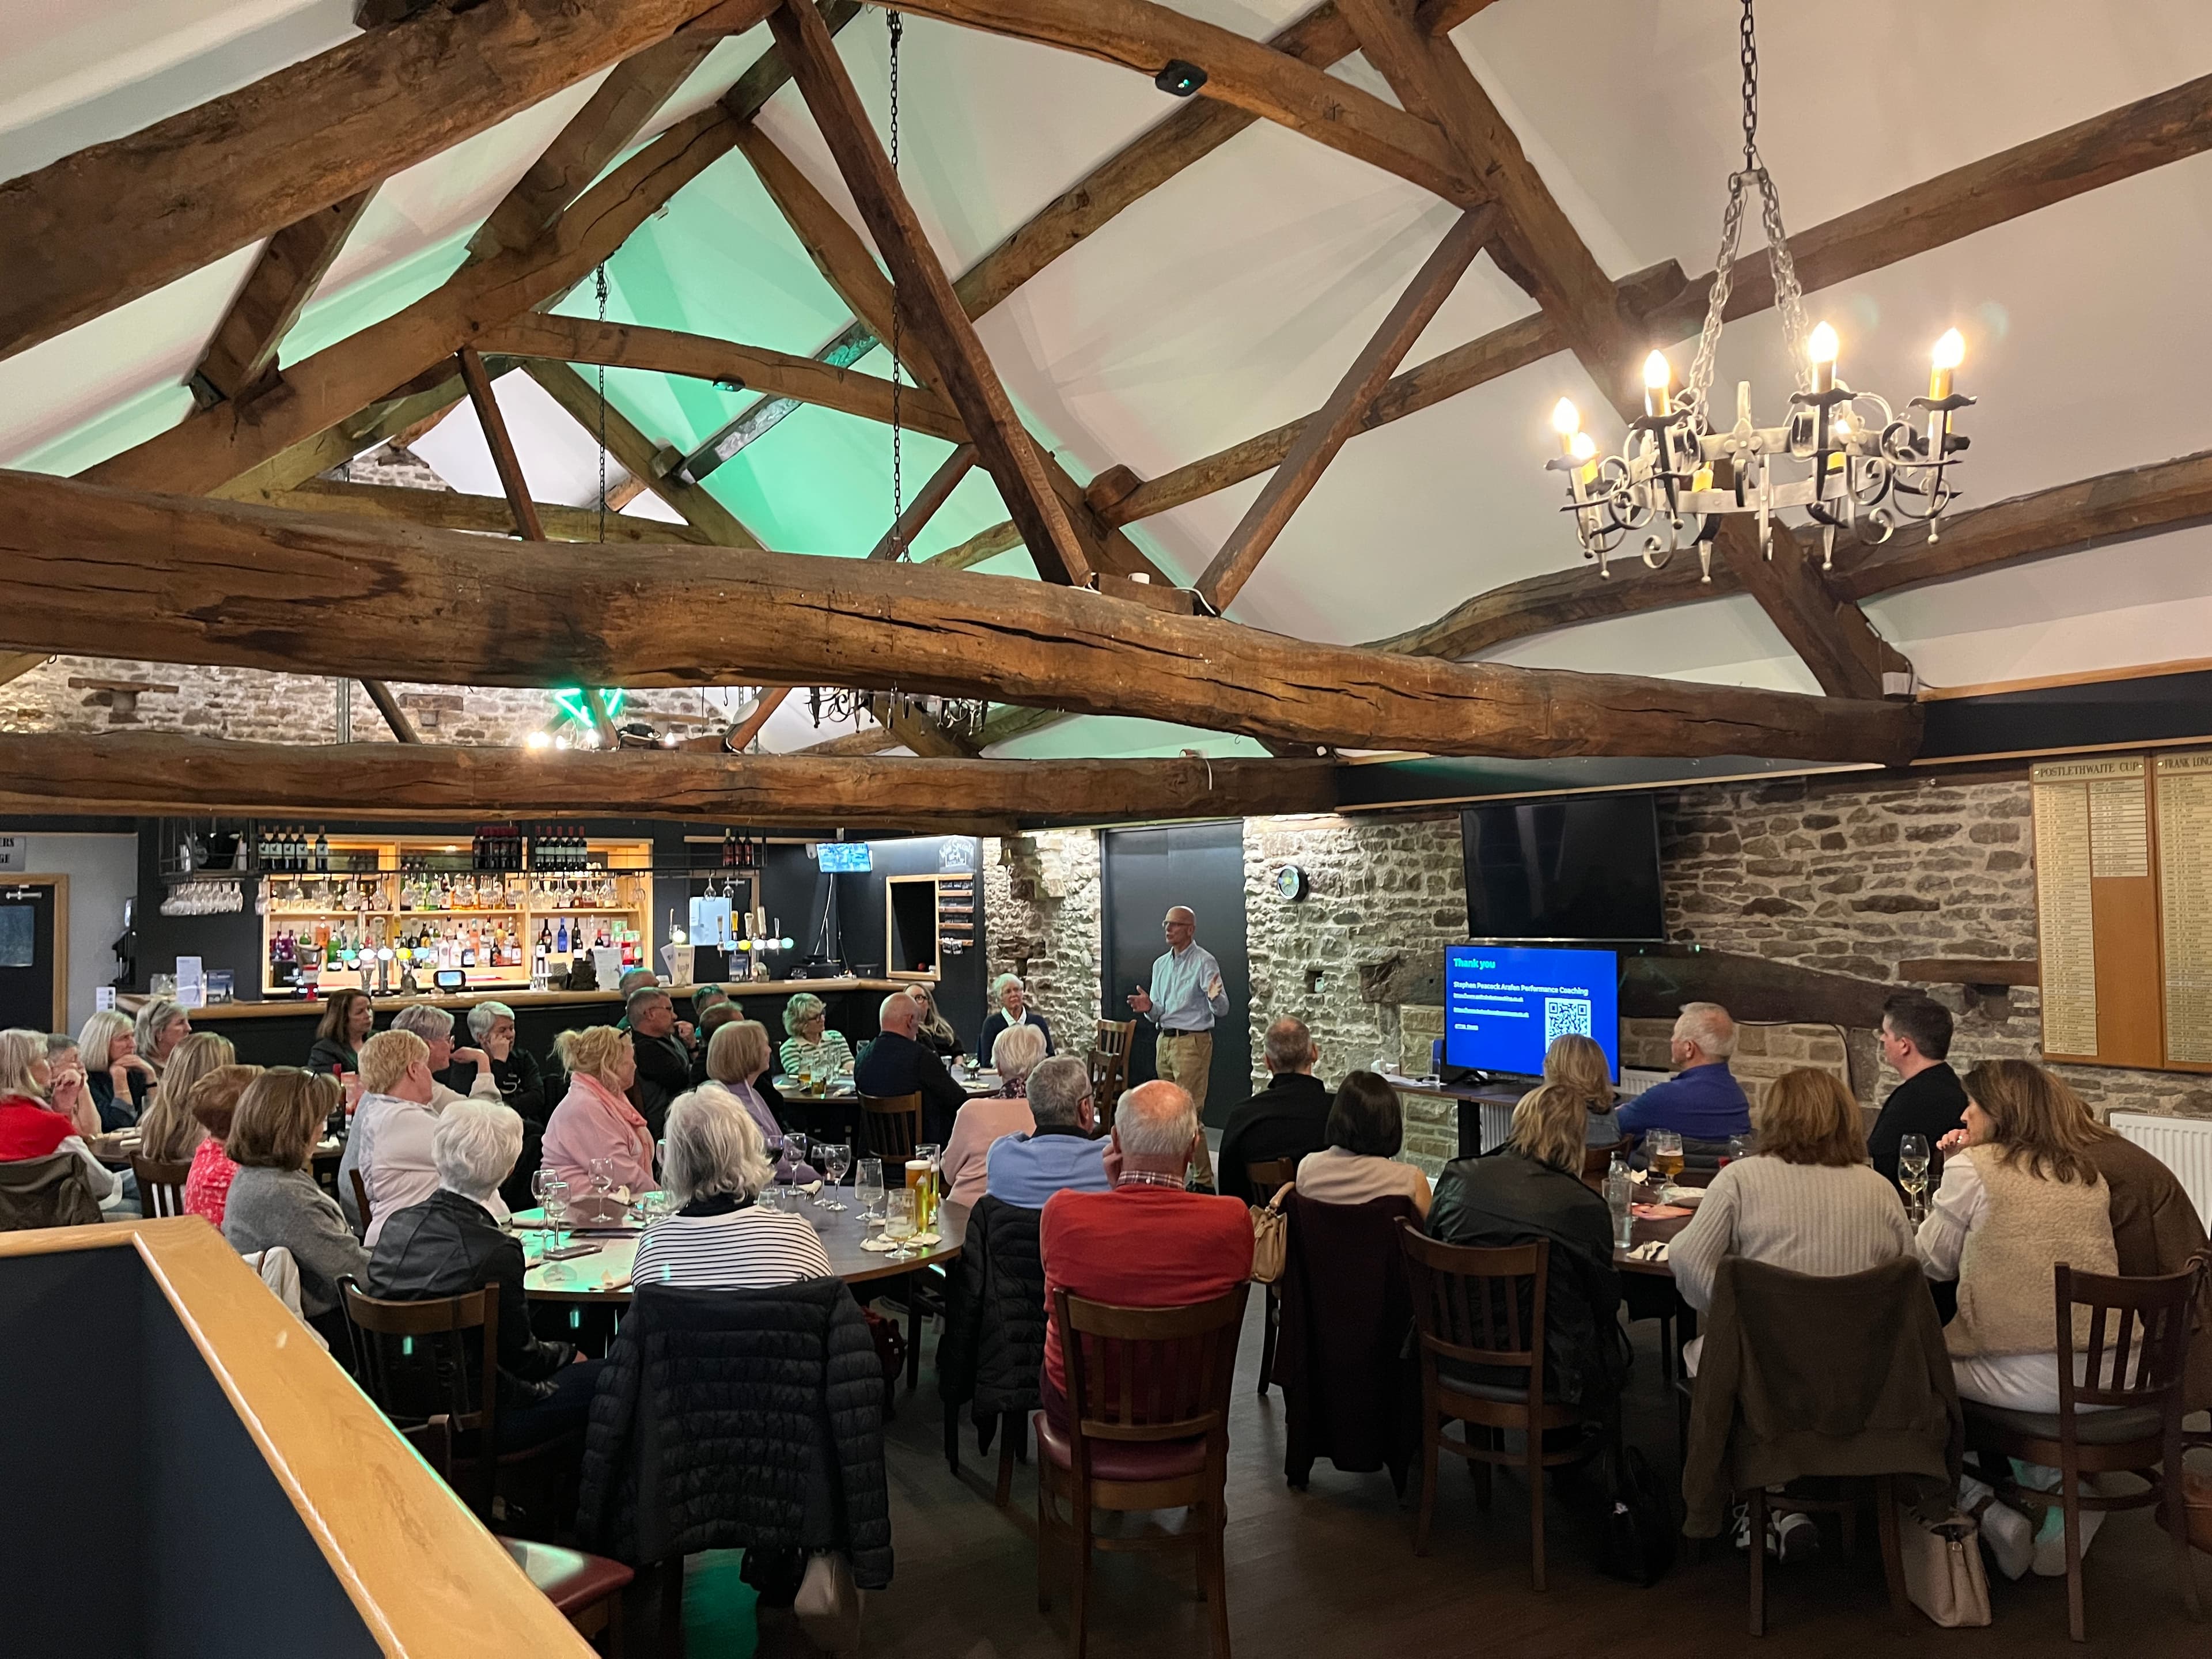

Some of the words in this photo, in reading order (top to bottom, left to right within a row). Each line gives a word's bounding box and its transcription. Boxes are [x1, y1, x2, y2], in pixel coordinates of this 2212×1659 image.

[2040, 763, 2115, 777] POSTLETHWAITE
[2120, 762, 2138, 772] CUP
[2165, 757, 2190, 769] FRANK
[1453, 958, 1479, 968] Thank
[1479, 960, 1496, 970] you
[1453, 981, 1476, 989] Stephen
[1521, 984, 1558, 993] Performance
[1559, 986, 1589, 996] Coaching
